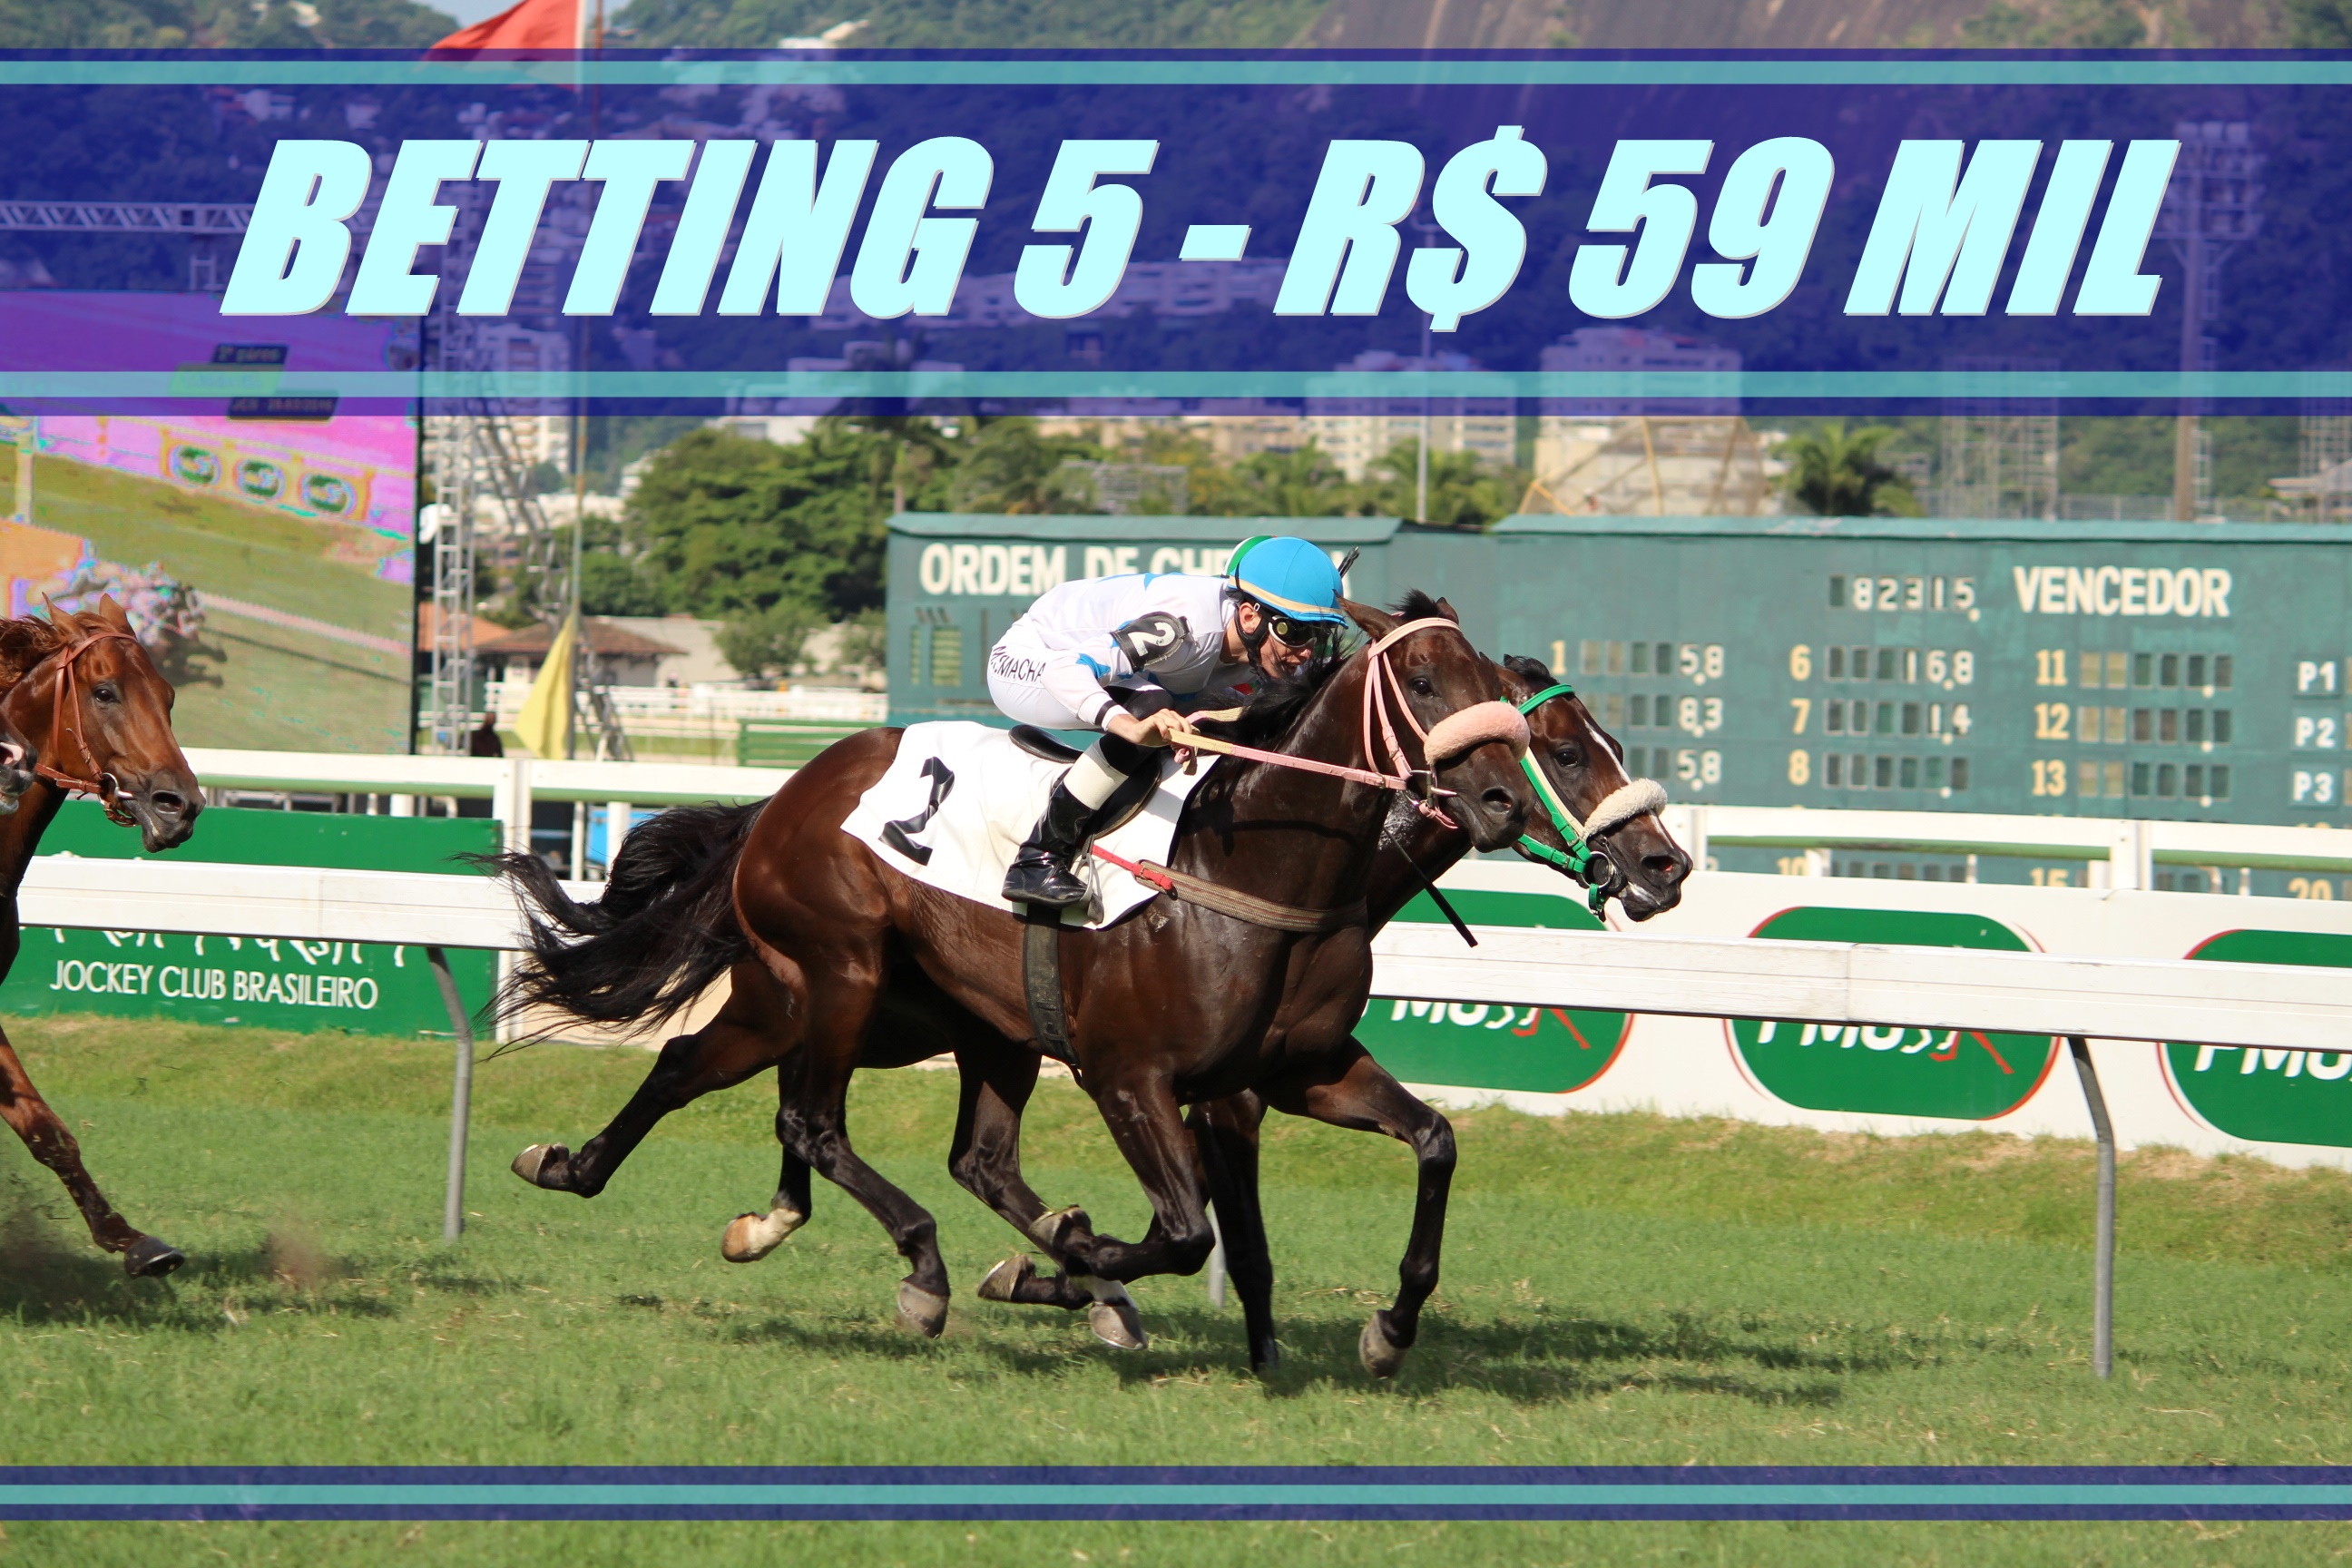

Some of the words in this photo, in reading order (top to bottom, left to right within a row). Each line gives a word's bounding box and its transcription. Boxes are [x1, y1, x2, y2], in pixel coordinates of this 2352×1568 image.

[919, 543, 1065, 596] ORDEM
[1084, 545, 1139, 579] DE
[2013, 565, 2232, 617] VENCEDOR
[1128, 622, 1175, 657] 2
[1550, 640, 1567, 675] 1
[1788, 644, 1812, 681] 6
[2035, 649, 2068, 686] 11
[2298, 661, 2336, 692] P1
[1789, 698, 1812, 734] 7
[2034, 702, 2071, 740] 12
[2295, 717, 2335, 749] P2
[1788, 749, 1810, 786] 8
[2031, 759, 2067, 797] 13
[2292, 771, 2334, 803] P3
[877, 756, 956, 867] 2
[50, 959, 153, 995] JOCKEY
[159, 965, 227, 1000] CLUB
[233, 970, 378, 1010] BRASILEIRO
